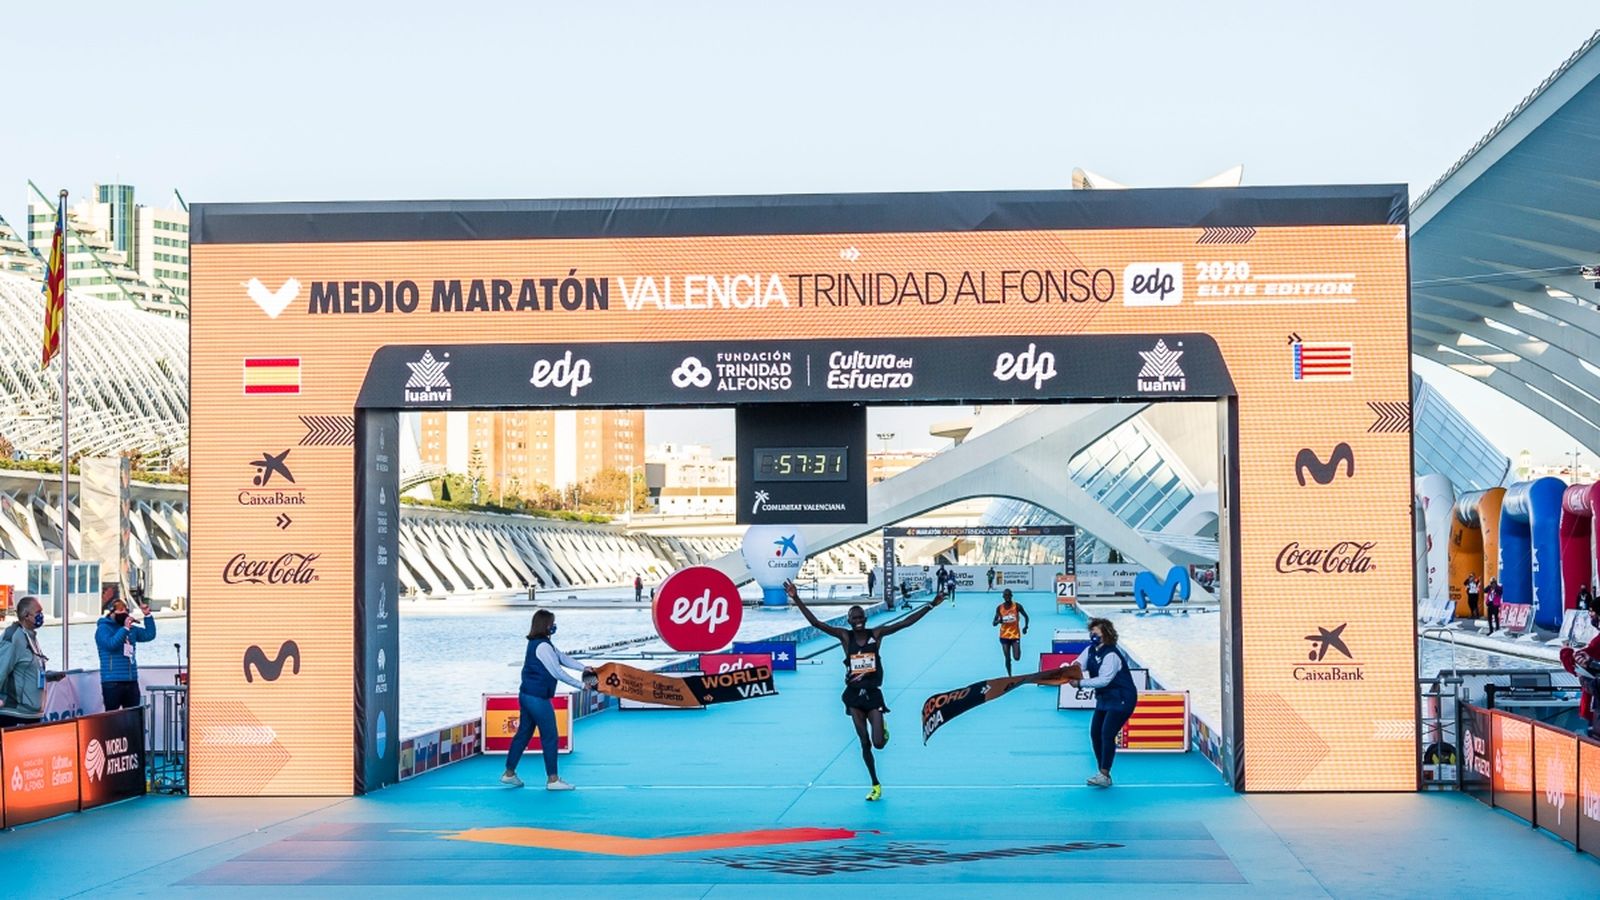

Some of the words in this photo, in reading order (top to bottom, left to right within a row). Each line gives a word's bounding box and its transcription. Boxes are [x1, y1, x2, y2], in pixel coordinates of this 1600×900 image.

[1196, 261, 1250, 281] 2020
[308, 280, 419, 314] MEDIO
[430, 268, 609, 312] MARATÓN
[1130, 268, 1176, 302] edp
[1197, 283, 1258, 297] ELITE
[1263, 282, 1353, 296] EDITION
[717, 350, 792, 362] FUNDACIÓN
[828, 350, 896, 370] Cultura
[896, 356, 913, 369] del
[529, 350, 593, 397] edp
[716, 363, 792, 378] TRINIDAD
[992, 342, 1057, 390] edp
[716, 377, 792, 391] ALFONSO
[827, 369, 914, 389] Esfuerzo
[1137, 378, 1187, 392] luanvi
[404, 388, 452, 402] luanvi
[237, 491, 306, 506] CaixaBank
[802, 503, 846, 511] VALENCIANA
[1058, 582, 1075, 597] 21
[669, 588, 730, 634] edp
[701, 667, 771, 689] WORLD
[1293, 666, 1364, 681] CaixaBank
[105, 737, 128, 755] WORLD
[106, 753, 139, 775] ATHLETICS
